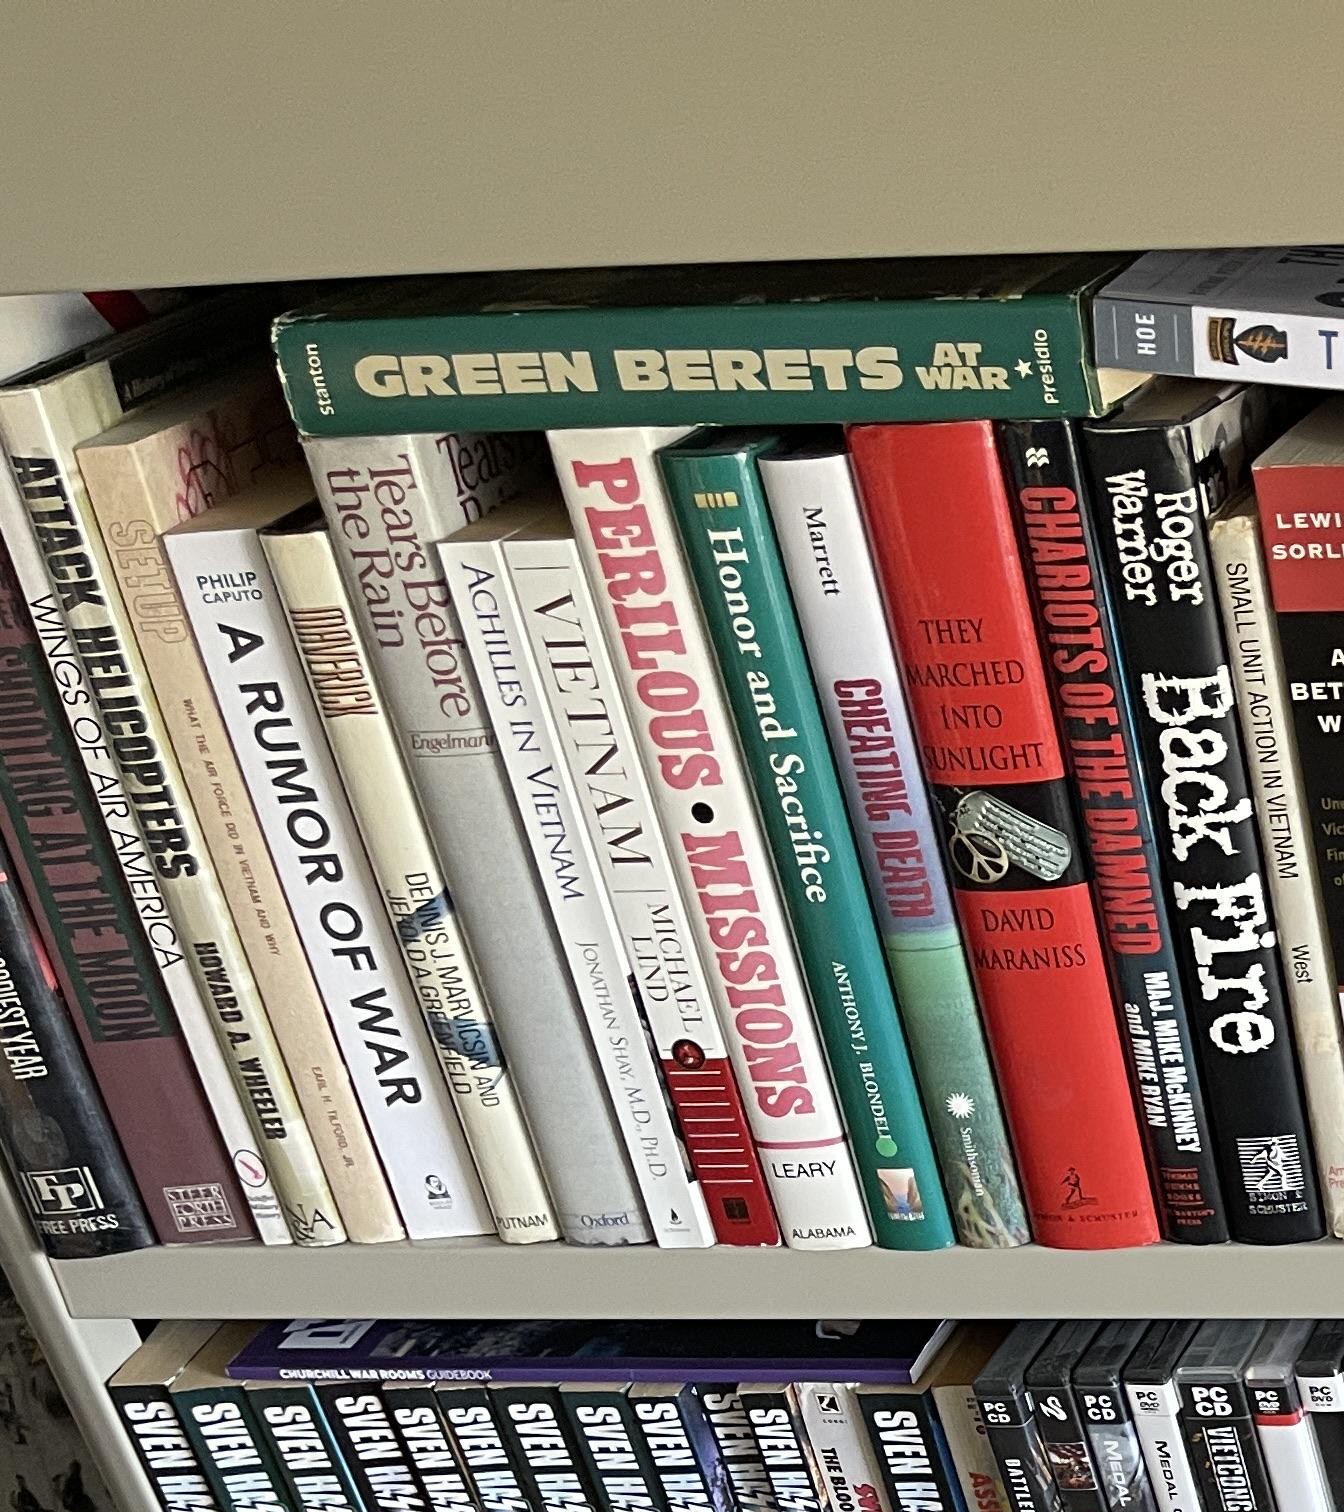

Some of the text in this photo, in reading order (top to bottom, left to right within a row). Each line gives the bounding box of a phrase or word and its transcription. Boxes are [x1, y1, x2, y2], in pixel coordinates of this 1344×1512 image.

[1136, 312, 1156, 355] HOE
[932, 342, 982, 367] AT
[1033, 328, 1060, 404] presidio
[306, 344, 334, 416] stanton
[354, 346, 904, 398] GREEN BERETS
[915, 366, 1010, 390] WAR
[802, 506, 841, 598] Marrett
[1105, 469, 1158, 606] Warner
[1154, 488, 1205, 606] Roger
[196, 572, 258, 590] PHILIP
[202, 589, 262, 606] CAPUTO
[919, 619, 983, 645] THEY
[906, 660, 1025, 688] MARCHED
[939, 704, 1004, 730] INTO
[925, 742, 1048, 772] SUNLIGHT
[1142, 665, 1254, 862] Back
[571, 457, 816, 1119] PERILOUS MISSIONS
[216, 622, 423, 1108] A RUMOR OF WAR
[982, 908, 1055, 932] DAVID
[975, 944, 1088, 971] MARANISS
[1174, 872, 1276, 1055] Fire
[772, 1160, 836, 1180] LEARY
[792, 1225, 856, 1241] ALABAMA
[280, 1368, 492, 1380] CHURCHILL WAR ROOMS GUIDEBOOK
